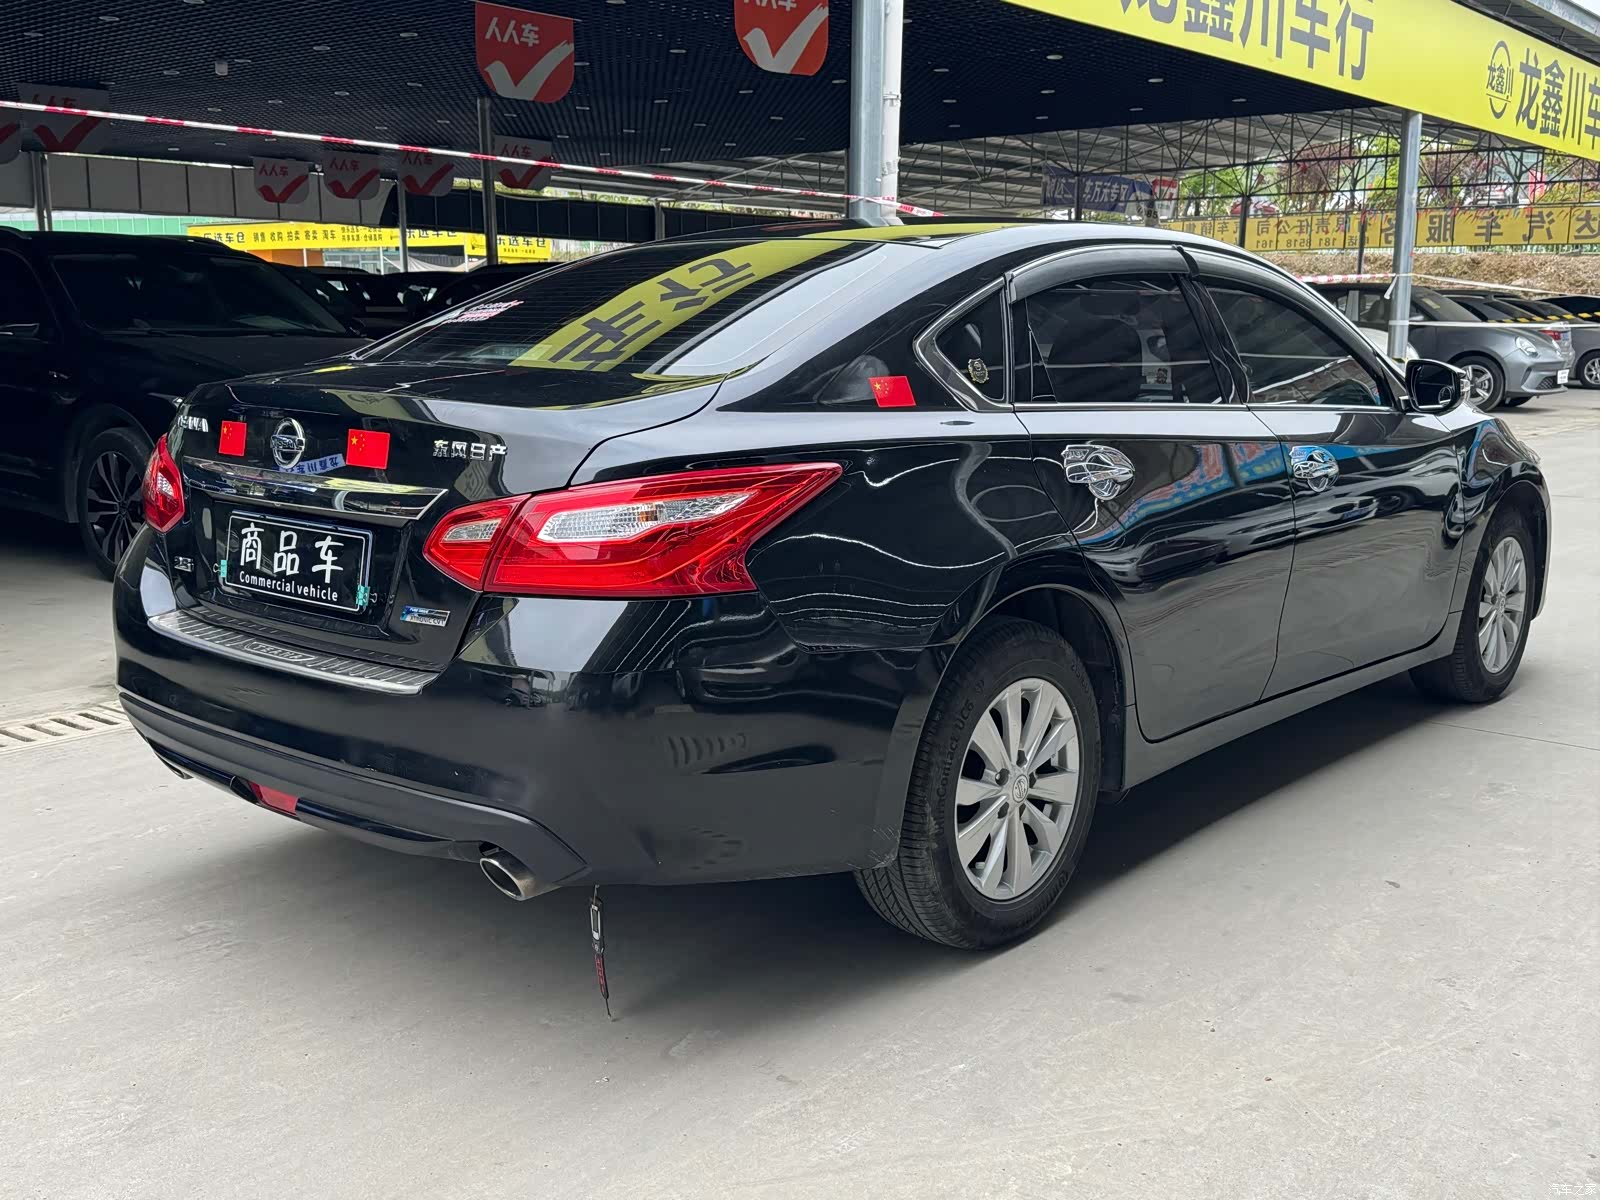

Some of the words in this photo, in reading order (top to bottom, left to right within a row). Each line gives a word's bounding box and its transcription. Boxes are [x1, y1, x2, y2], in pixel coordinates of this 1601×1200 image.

[485, 17, 540, 47] 人人车
[1486, 62, 1514, 97] 龙鑫川
[259, 163, 288, 177] 人人车
[330, 157, 359, 171] 人人车
[433, 440, 507, 461] 东风日产
[240, 522, 344, 584] 商品车
[239, 570, 295, 594] Commercial
[298, 583, 338, 601] vehicle
